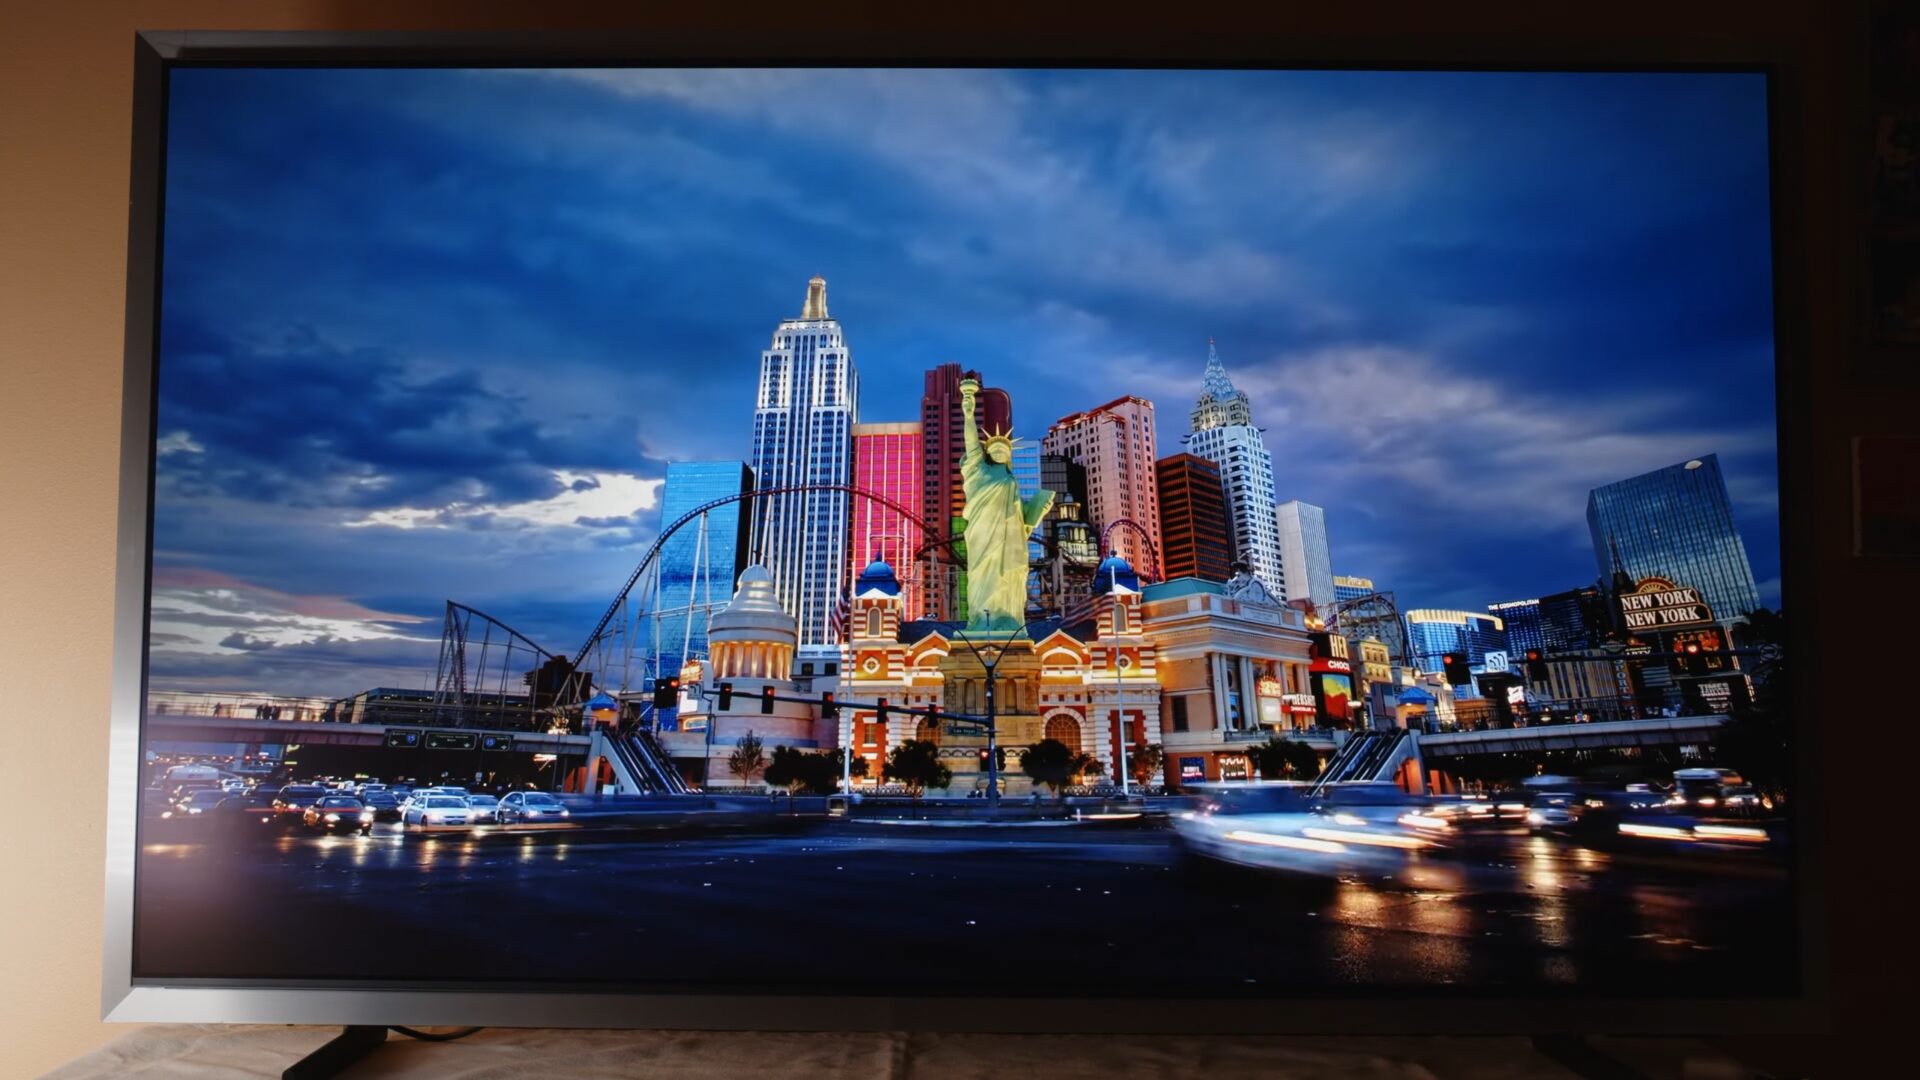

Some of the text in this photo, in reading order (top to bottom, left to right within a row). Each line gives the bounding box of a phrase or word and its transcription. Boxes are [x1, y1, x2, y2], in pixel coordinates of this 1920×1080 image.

[1499, 598, 1540, 609] COSMOPOLITAN
[1621, 589, 1696, 610] NEW YORK
[1625, 606, 1701, 627] NEW YORK
